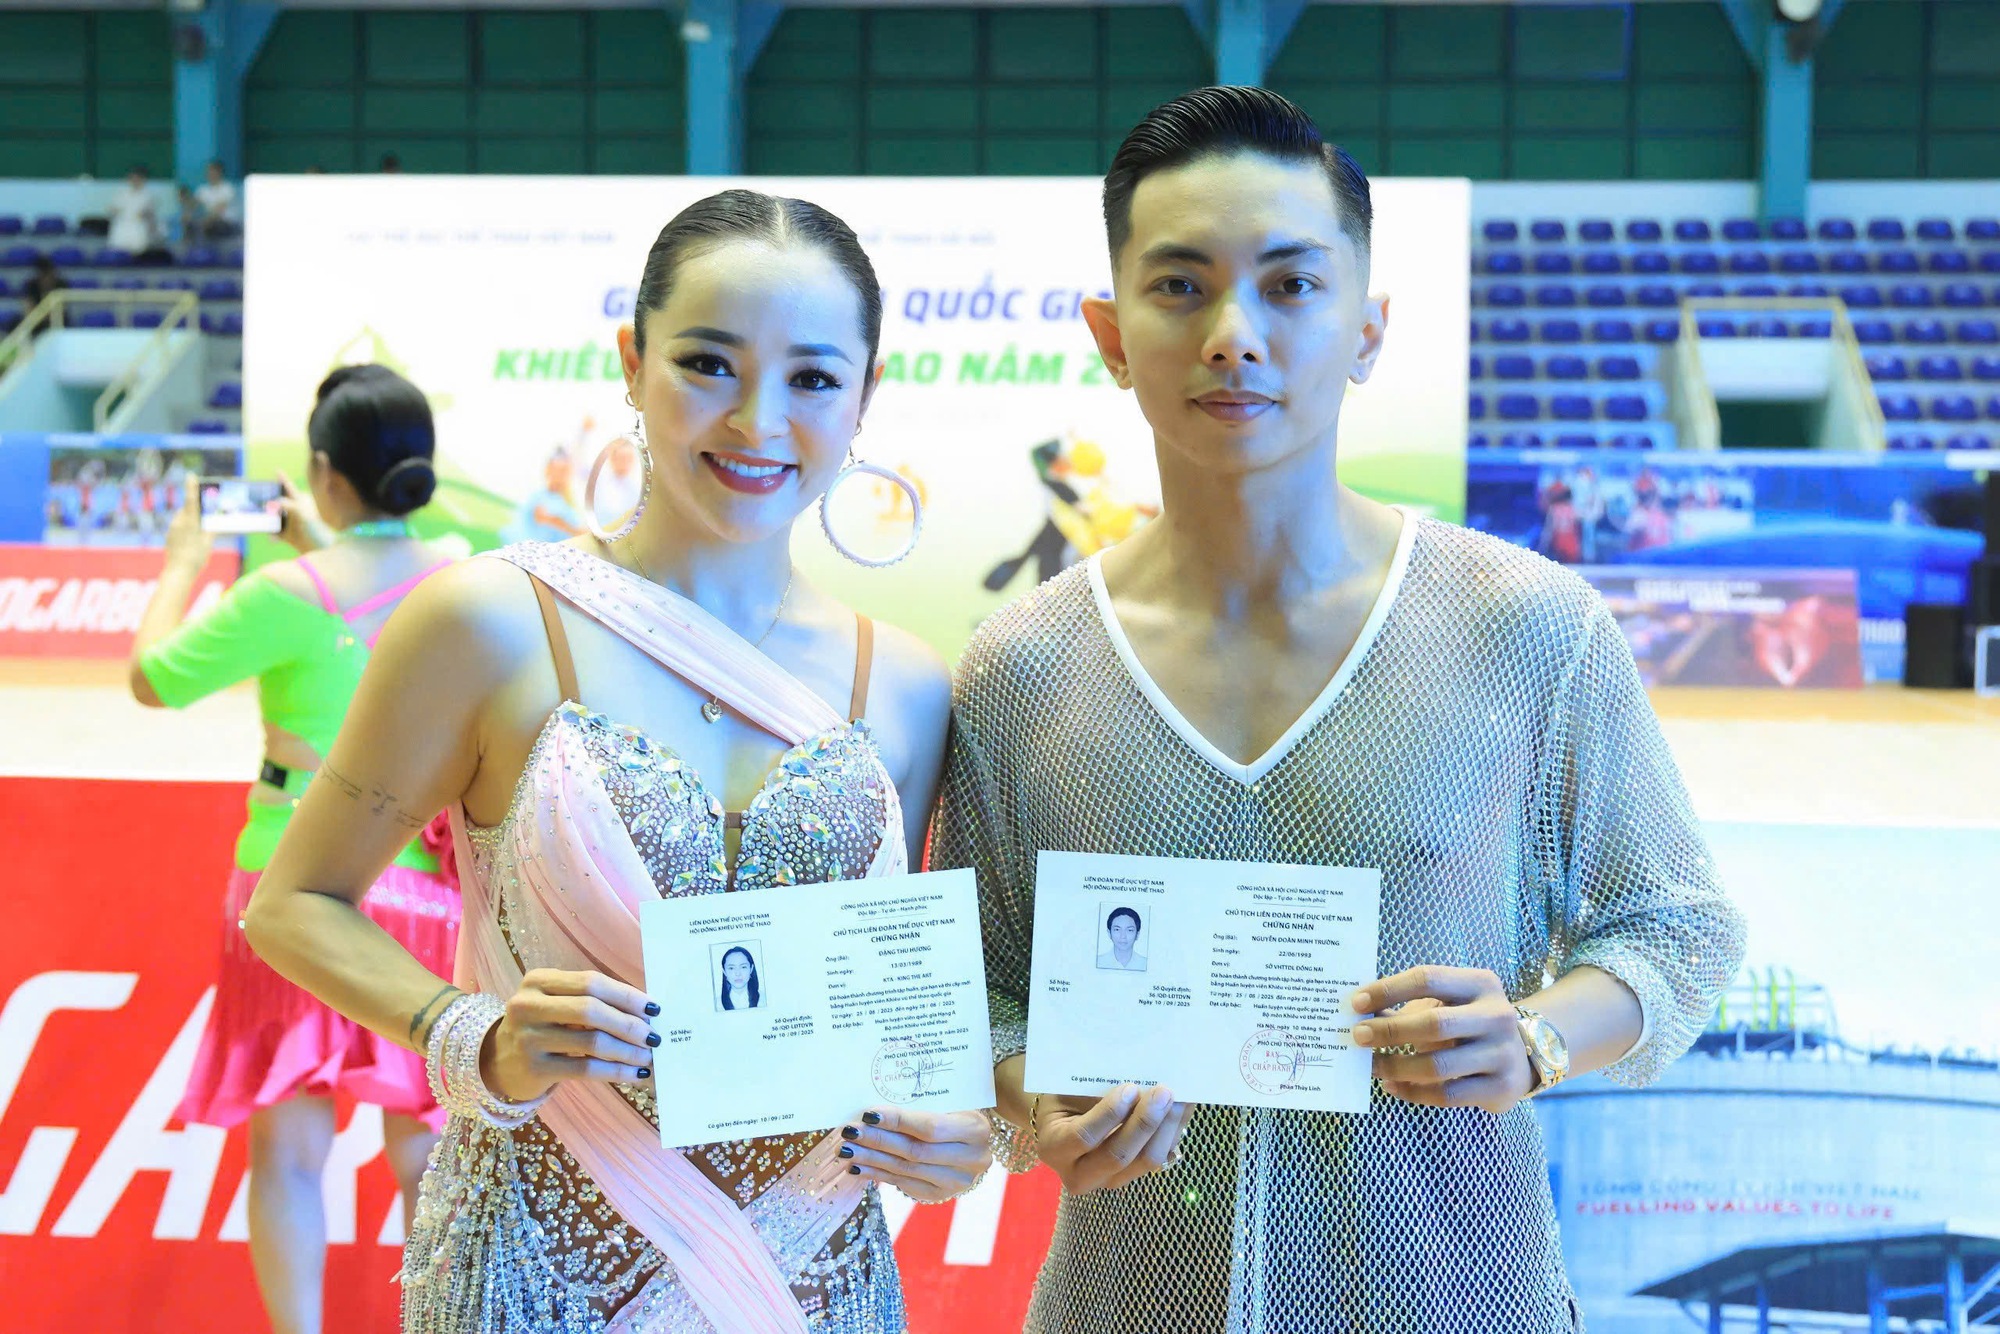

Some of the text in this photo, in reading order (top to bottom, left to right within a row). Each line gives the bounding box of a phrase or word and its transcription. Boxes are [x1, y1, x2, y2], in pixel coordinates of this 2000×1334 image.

[902, 269, 1022, 323] QUỐC
[743, 913, 755, 921] VIỆT
[1224, 907, 1239, 915] CHỦ
[1256, 909, 1270, 917] LIÊN
[1271, 910, 1290, 918] ĐOÀN
[1321, 913, 1335, 922] VIỆT
[833, 928, 847, 936] CHỦ
[847, 928, 863, 936] TỊCH
[863, 925, 877, 933] LIÊN
[878, 923, 896, 931] ĐOÀN
[911, 921, 924, 929] DỤC
[925, 918, 939, 927] VIỆT
[1262, 919, 1314, 931] CHỨNG NHẬN
[870, 930, 920, 942] CHỨNG NHẬN
[1705, 1199, 1802, 1215] VALUES
[1811, 1201, 1839, 1216] TO
